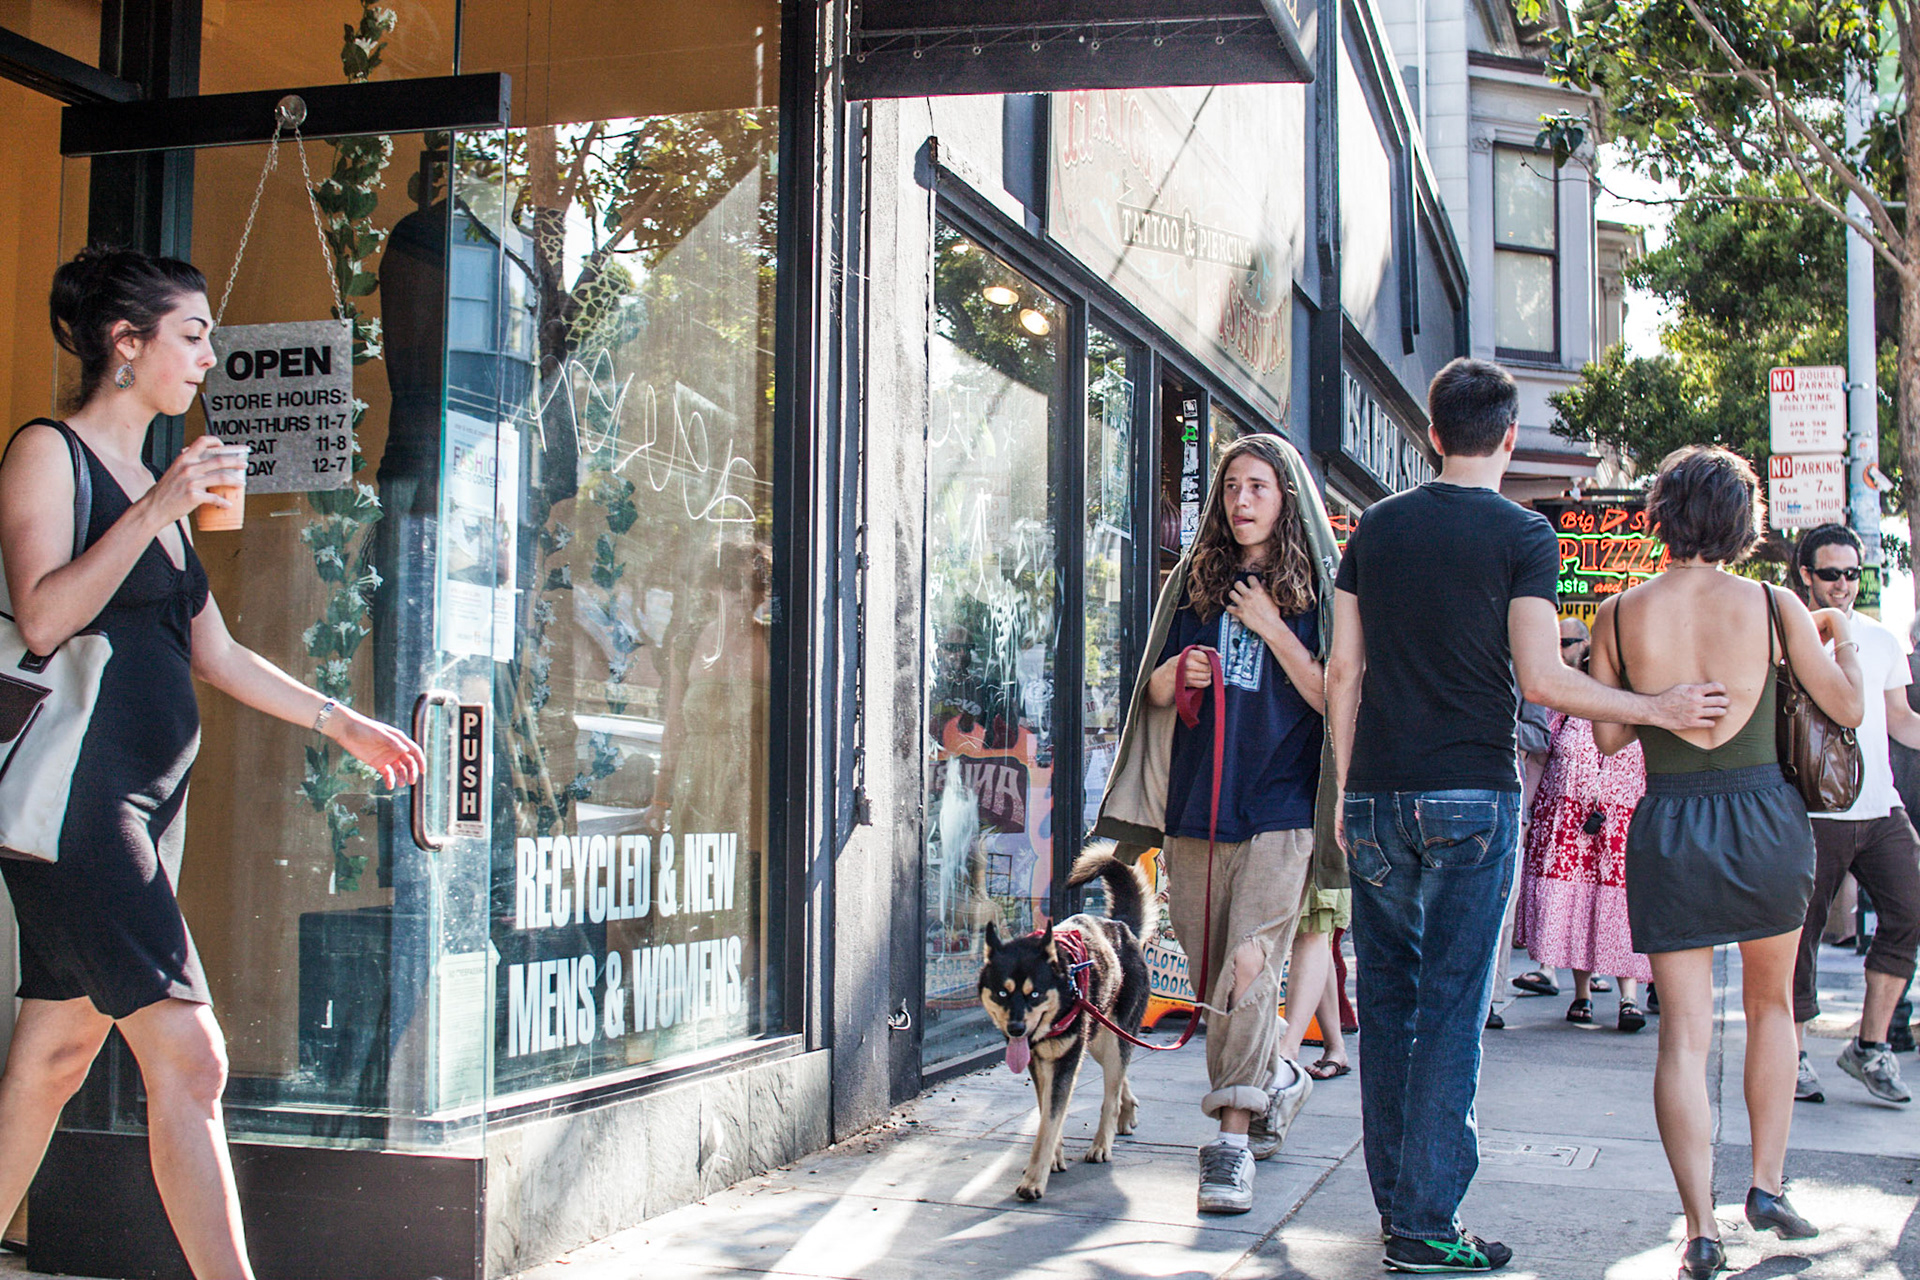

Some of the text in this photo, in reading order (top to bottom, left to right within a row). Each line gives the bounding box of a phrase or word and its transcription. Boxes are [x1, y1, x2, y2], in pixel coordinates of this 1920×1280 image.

[1122, 209, 1251, 266] TATTOO & PIERCING
[226, 346, 331, 381] OPEN
[1773, 371, 1793, 391] NO
[1799, 381, 1839, 390] PARKING
[1800, 371, 1836, 380] DOUBLE
[212, 389, 347, 411] STORE HOURS:
[1784, 393, 1830, 402] ANYTIME
[213, 414, 347, 436] MON-THURS 11-7
[316, 436, 347, 451] 11-8
[312, 457, 347, 473] 12-7
[453, 446, 508, 480] FASHION
[1771, 457, 1792, 477] NO
[1795, 459, 1840, 475] PARKING
[1815, 499, 1840, 511] THUR
[1561, 510, 1595, 533] Big
[1557, 577, 1589, 594] asta
[1593, 579, 1623, 594] and
[461, 712, 479, 815] PUSH
[516, 833, 737, 930] RECYCLED & NEW
[508, 954, 597, 1057] MENS
[604, 951, 625, 1039] &
[632, 935, 741, 1032] WOMENS
